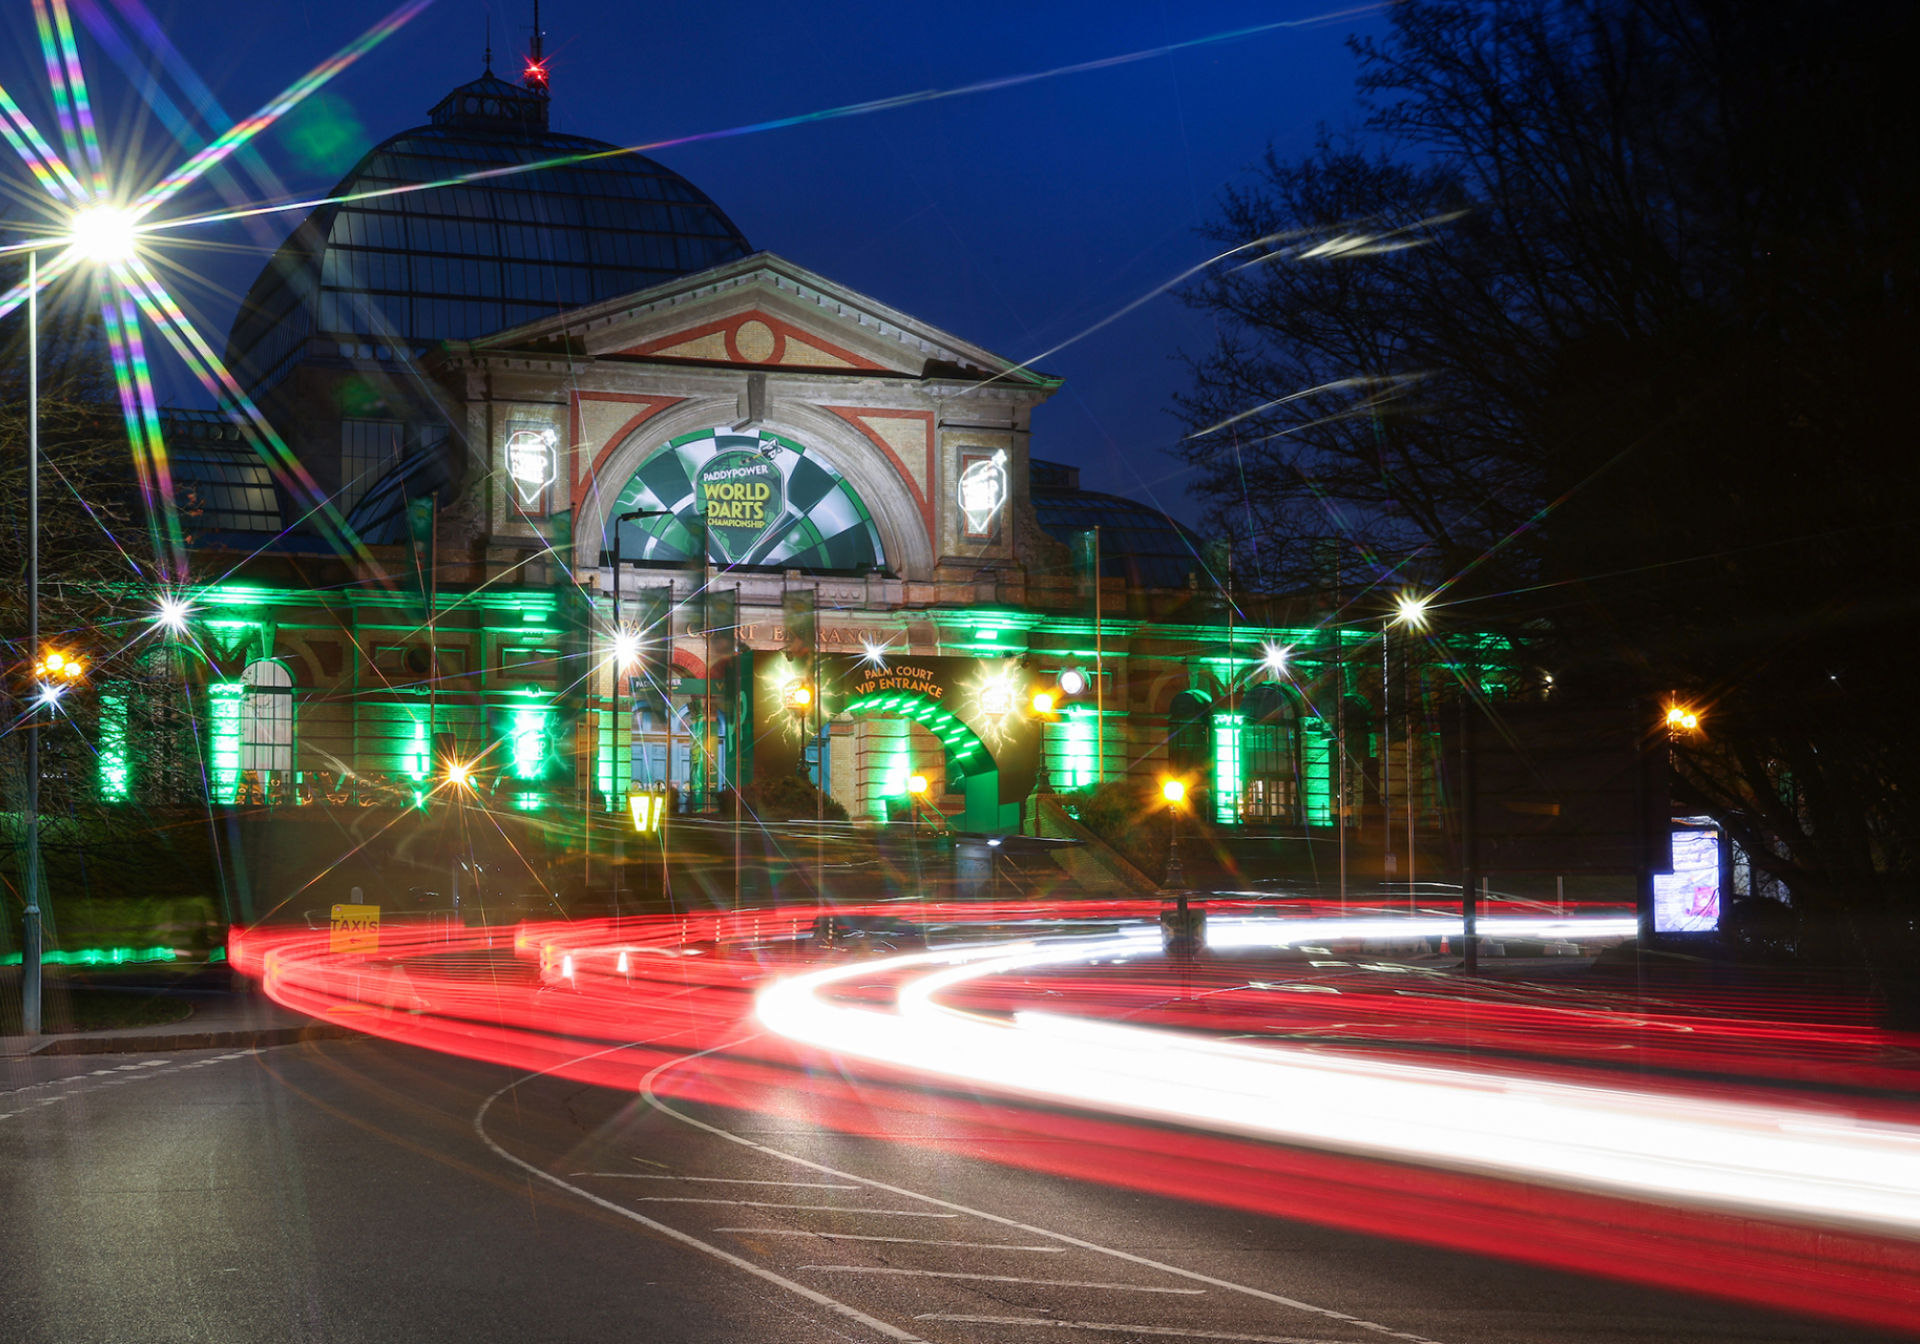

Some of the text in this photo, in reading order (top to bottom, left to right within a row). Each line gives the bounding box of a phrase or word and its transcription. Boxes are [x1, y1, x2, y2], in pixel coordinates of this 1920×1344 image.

[703, 465, 768, 481] PADDYPOWER
[703, 483, 770, 501] WORLD
[708, 501, 764, 519] DARTS
[707, 518, 766, 528] CHAMPIONSHIP
[864, 666, 934, 680] PALM COURT
[855, 678, 943, 698] VIP ENTRANCE
[331, 919, 378, 933] TAXIS
